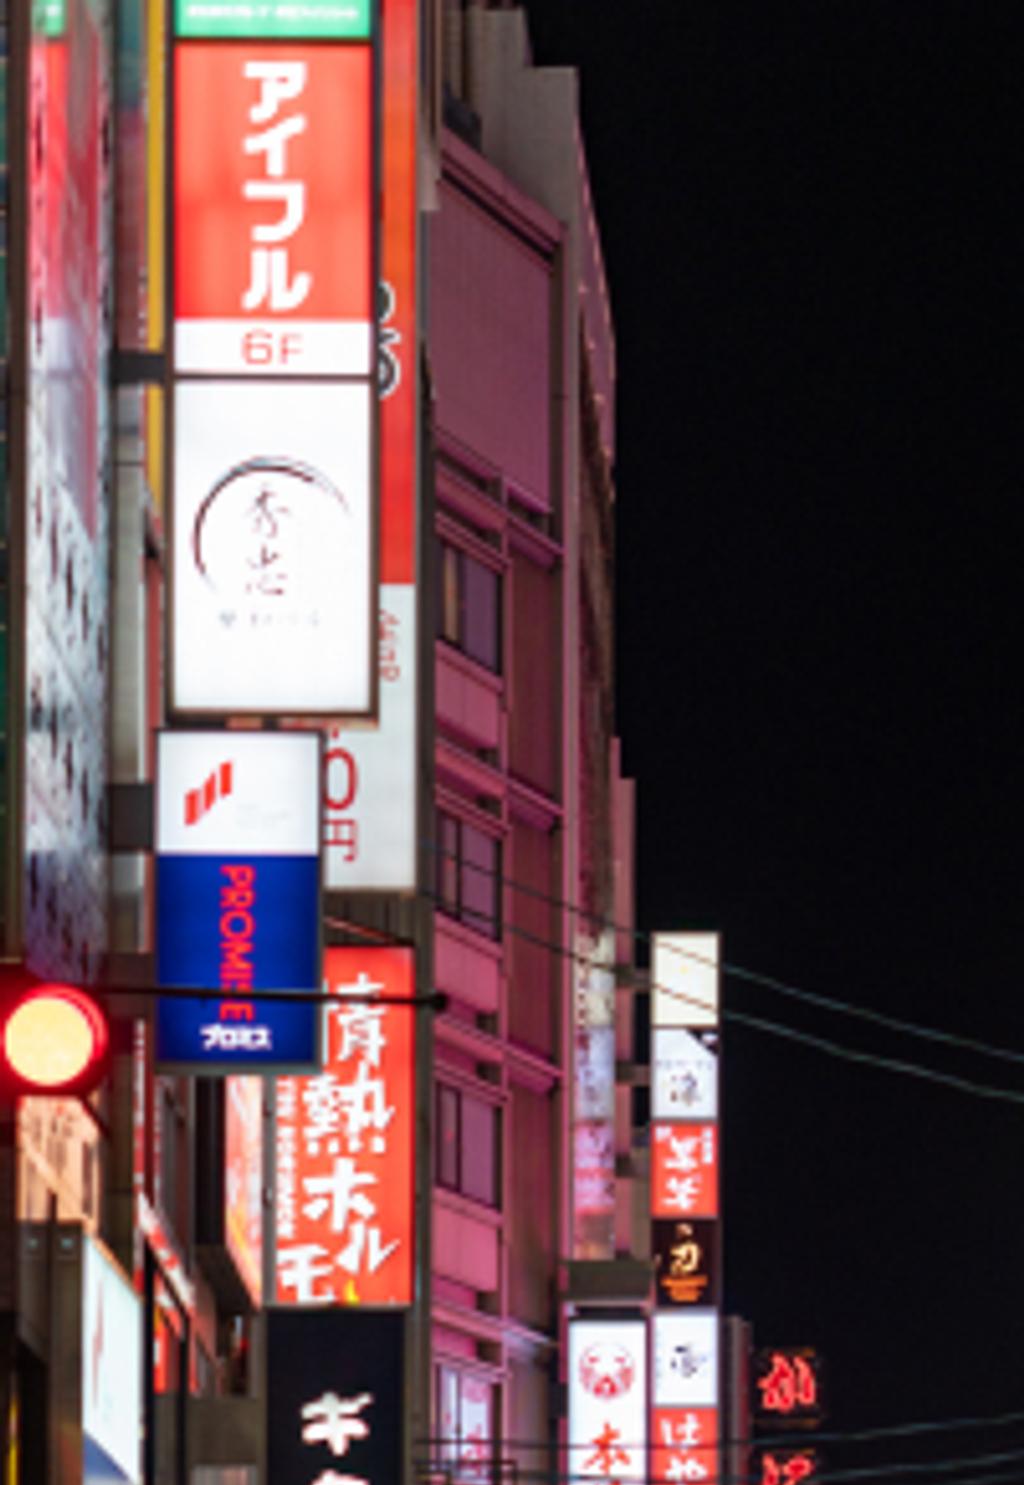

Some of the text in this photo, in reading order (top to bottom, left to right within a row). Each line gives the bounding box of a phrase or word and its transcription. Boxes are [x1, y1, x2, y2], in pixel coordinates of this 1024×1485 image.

[242, 61, 310, 310] アイフル
[241, 329, 303, 365] 6F
